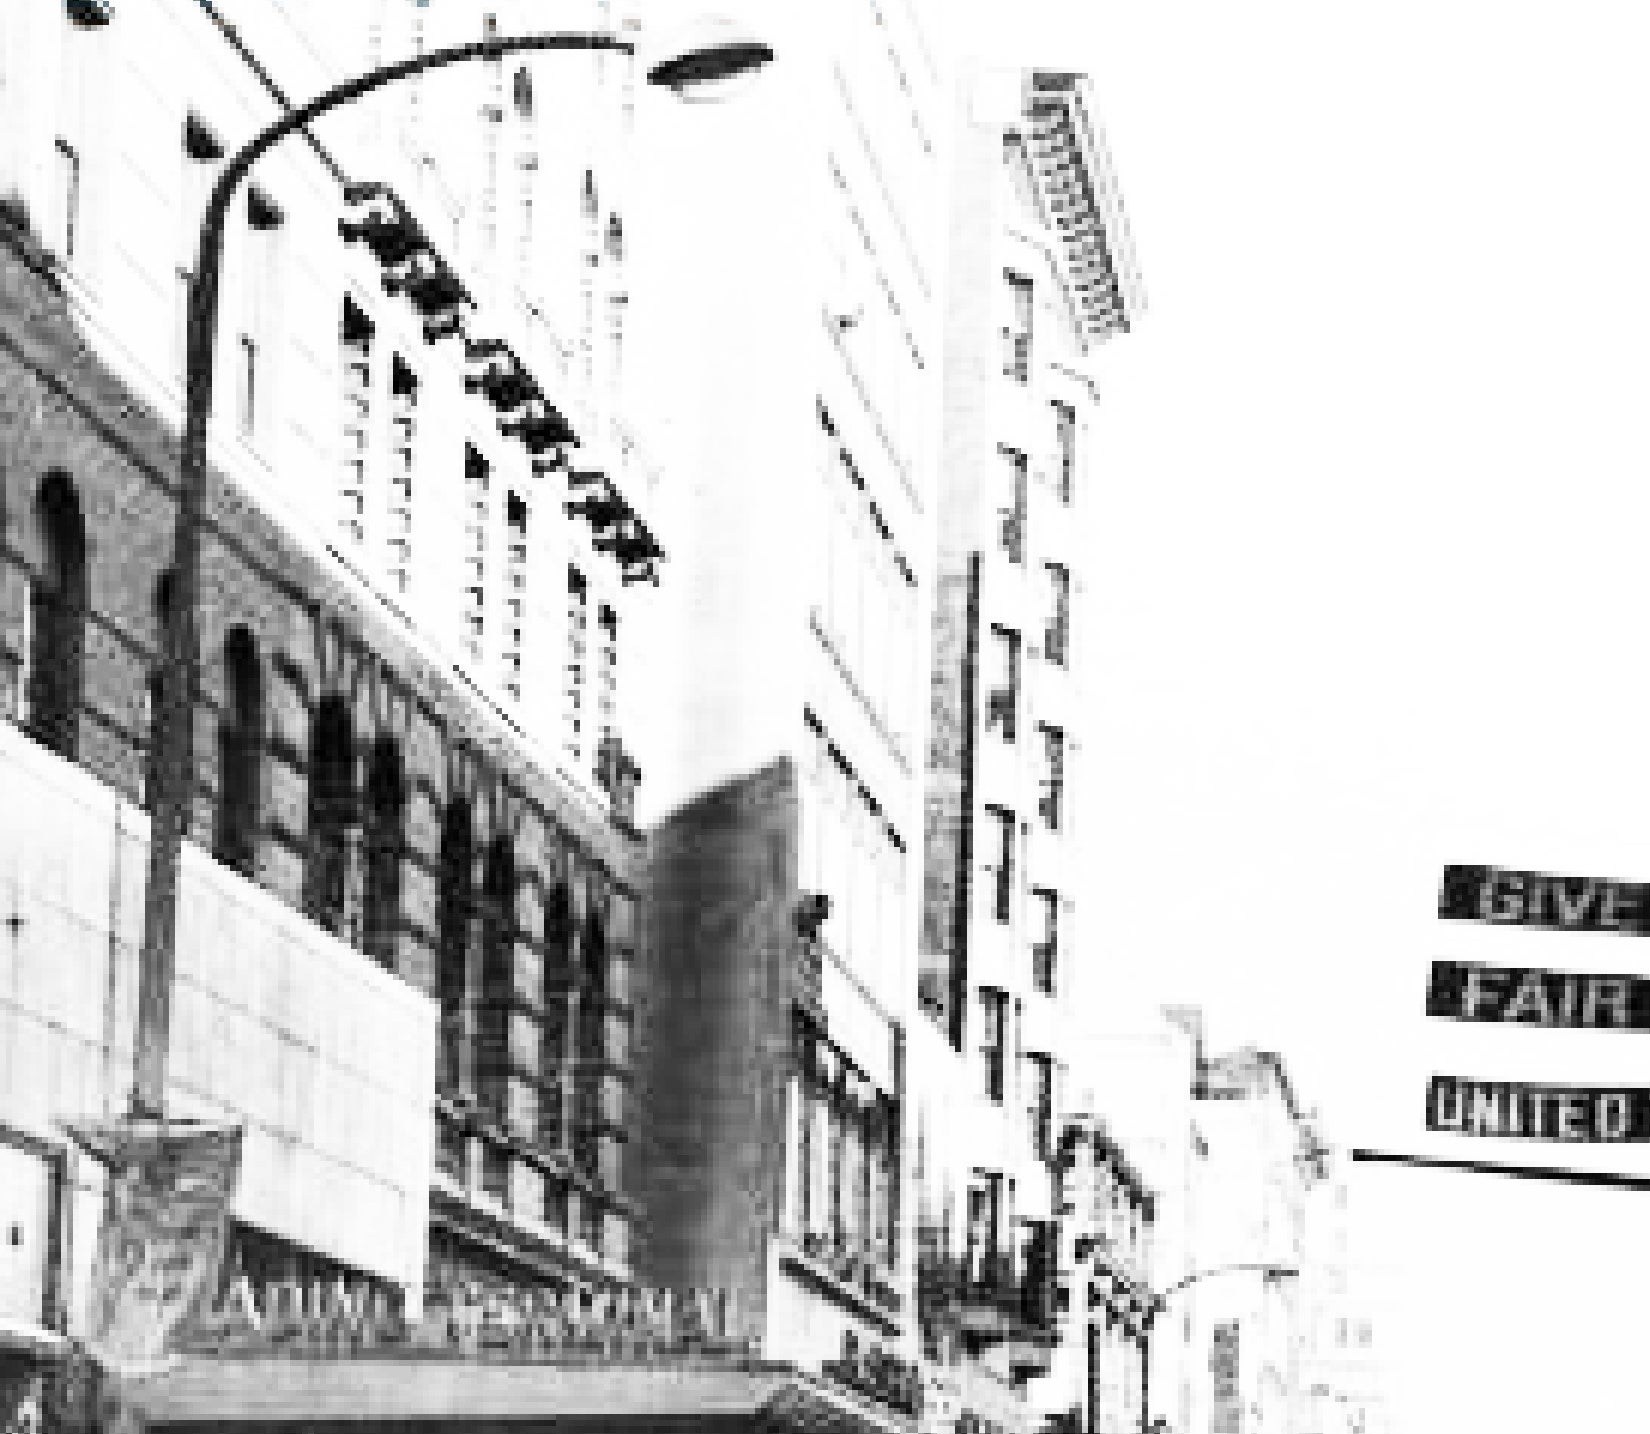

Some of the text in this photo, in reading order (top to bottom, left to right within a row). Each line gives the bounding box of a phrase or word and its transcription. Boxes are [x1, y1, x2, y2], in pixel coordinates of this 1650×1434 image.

[1479, 876, 1642, 927] GIVE
[1467, 972, 1630, 1026] FAIR
[1434, 1083, 1626, 1140] UNITED
